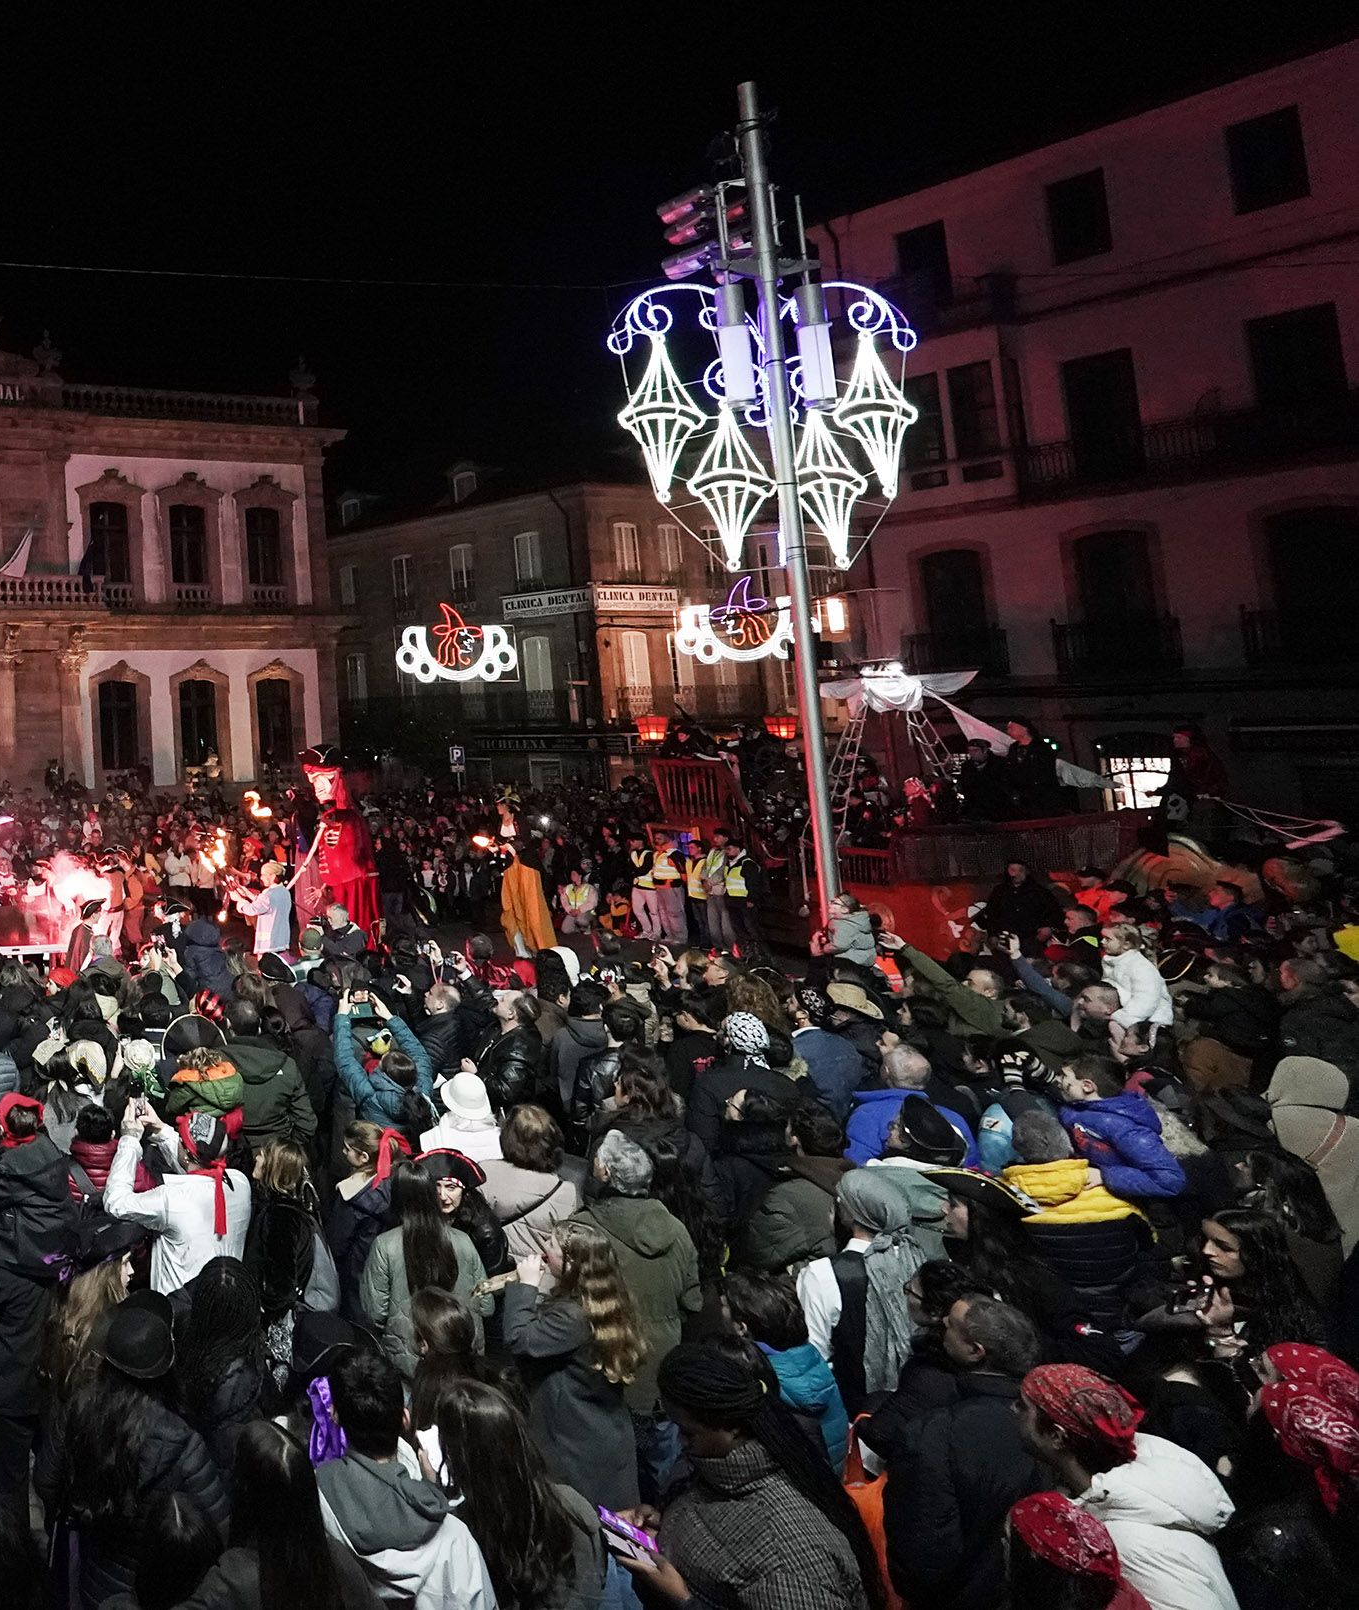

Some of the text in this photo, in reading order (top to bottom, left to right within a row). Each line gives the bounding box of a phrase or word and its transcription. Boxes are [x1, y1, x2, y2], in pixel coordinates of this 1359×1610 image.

[505, 597, 543, 611] CLINICA
[548, 592, 589, 606] DENTAL
[597, 591, 676, 602] CLINICA DENTAL
[453, 749, 462, 761] P
